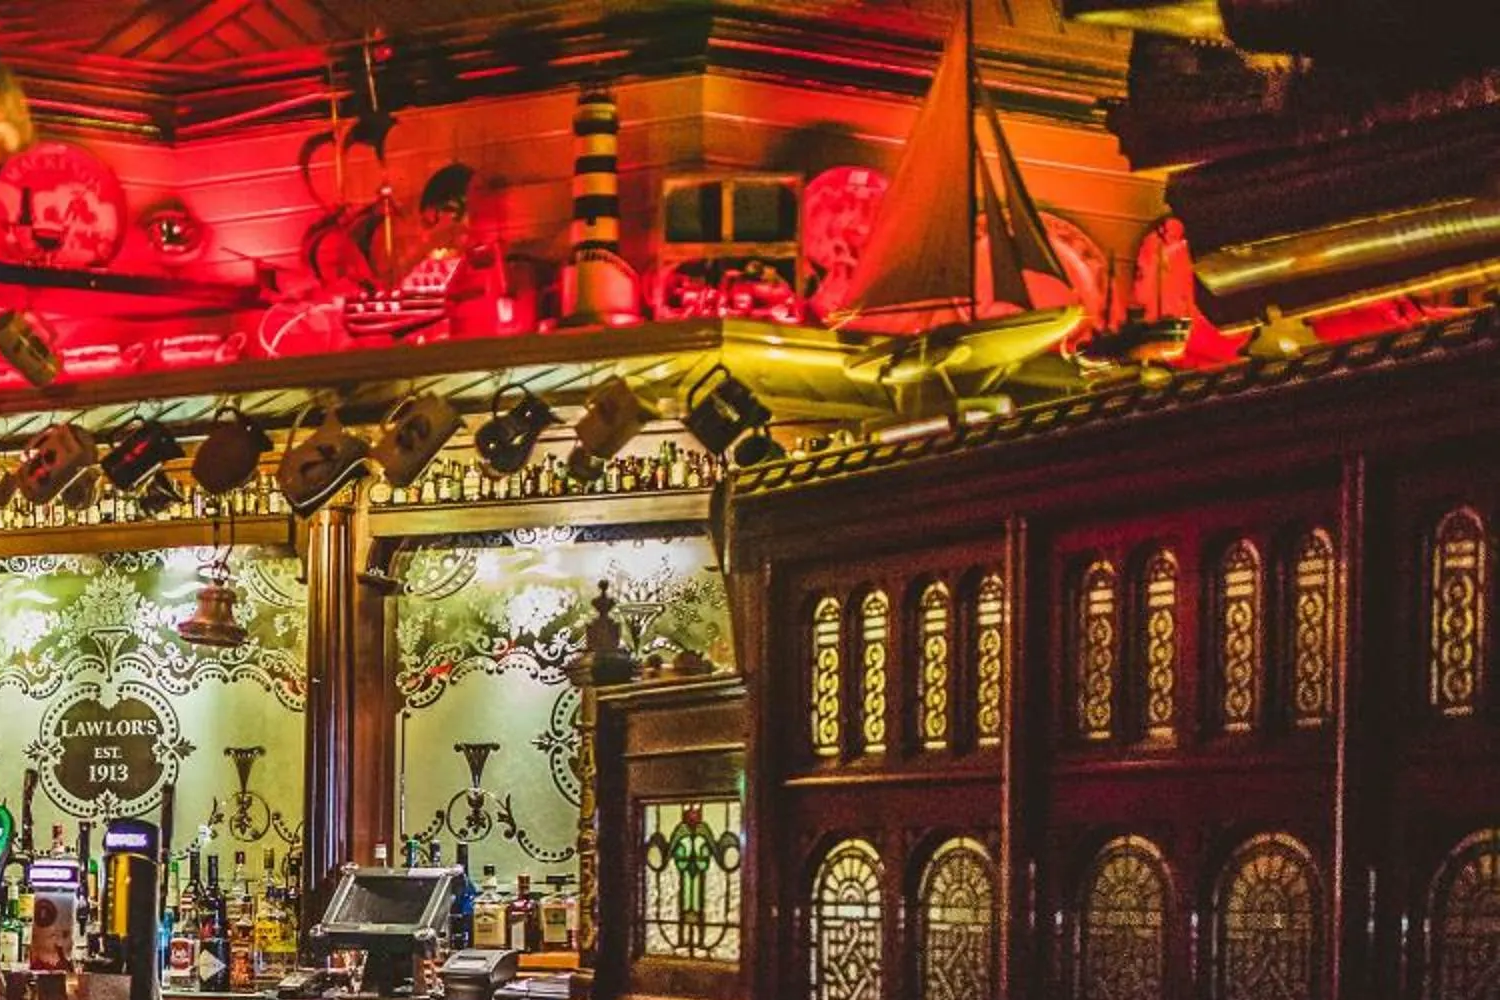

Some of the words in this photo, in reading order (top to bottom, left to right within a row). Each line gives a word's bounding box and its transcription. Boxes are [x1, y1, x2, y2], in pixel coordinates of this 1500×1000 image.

[60, 719, 158, 737] LAWLOR'S
[94, 747, 123, 759] EST.
[89, 764, 129, 783] 1913
